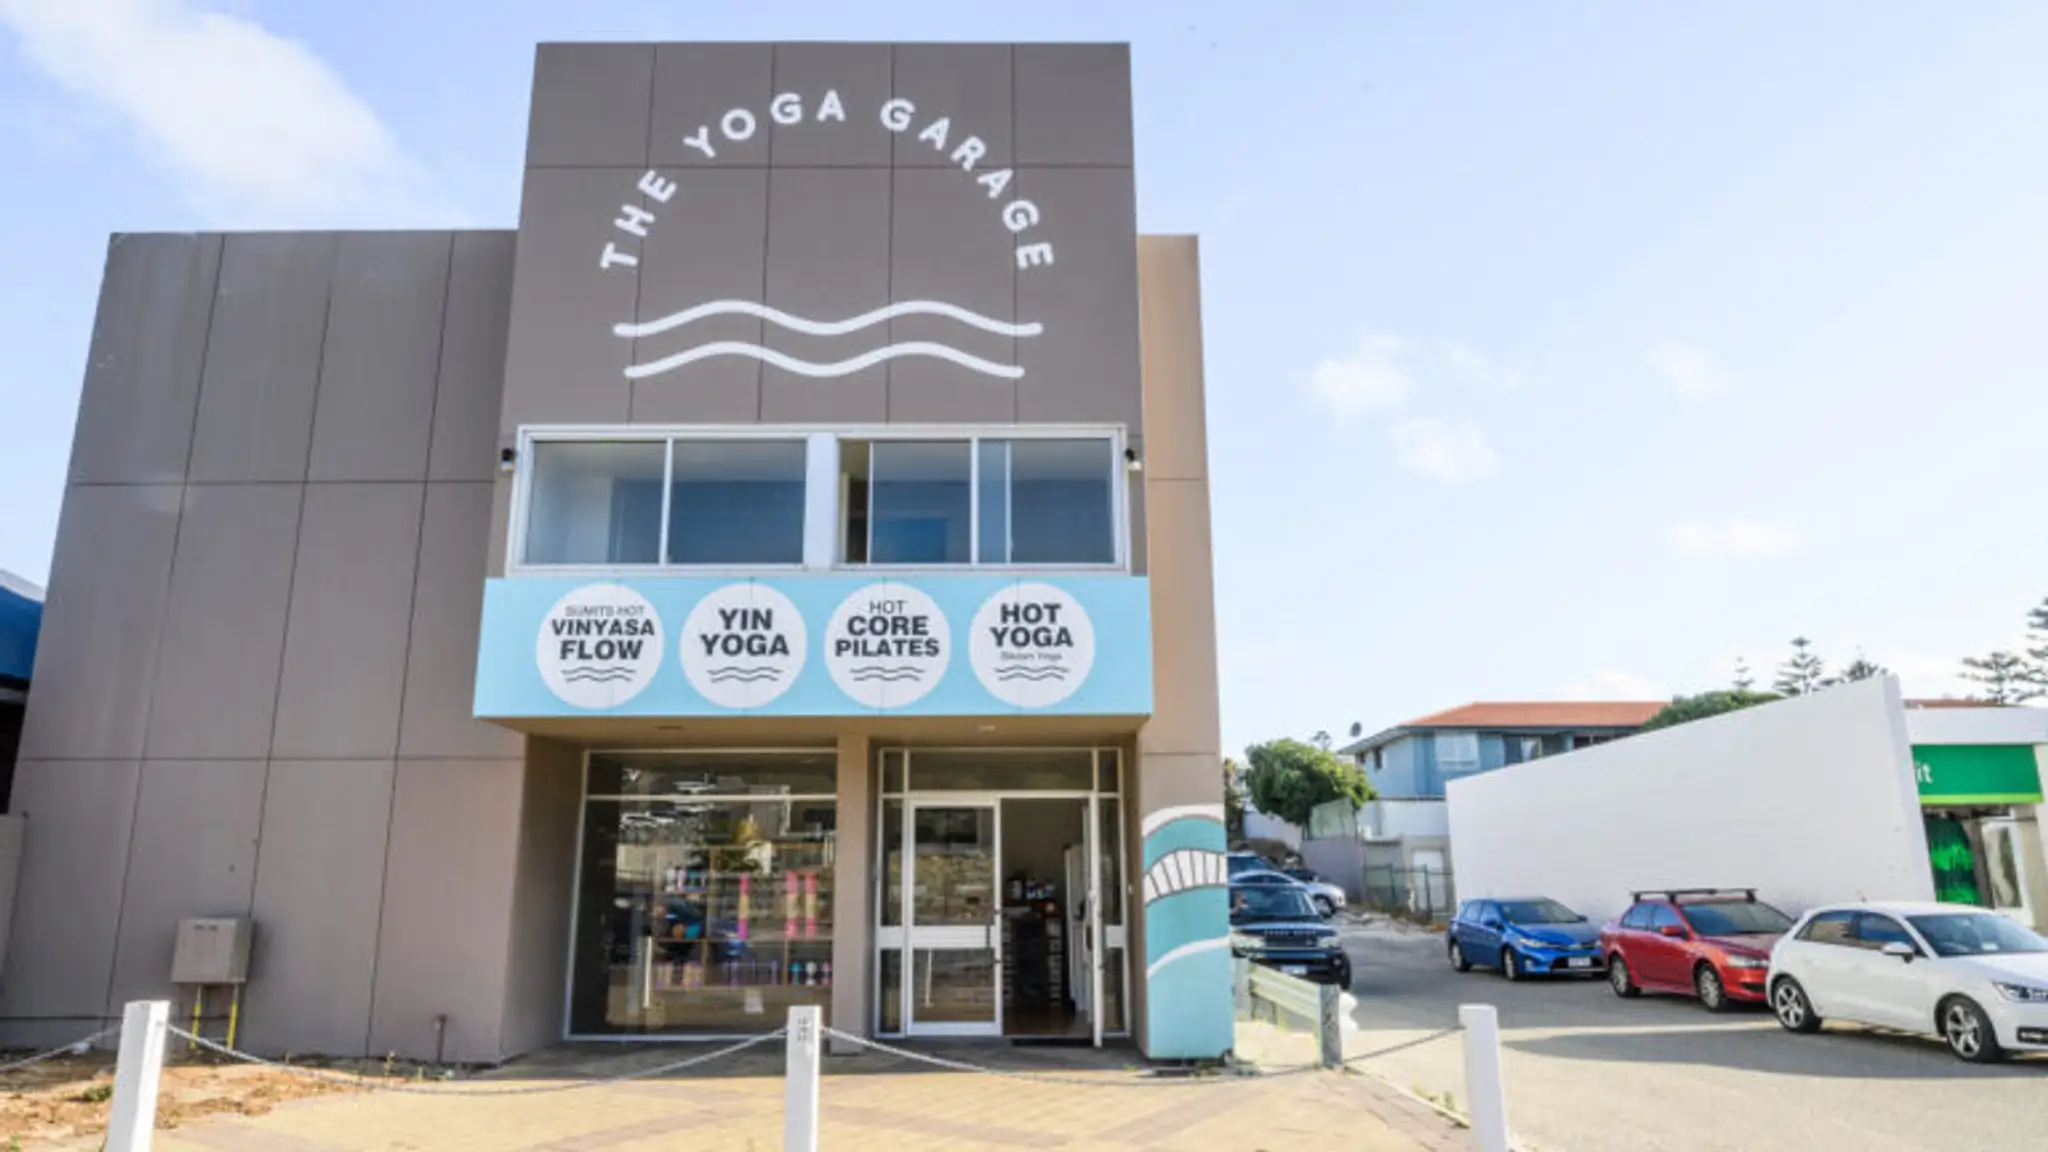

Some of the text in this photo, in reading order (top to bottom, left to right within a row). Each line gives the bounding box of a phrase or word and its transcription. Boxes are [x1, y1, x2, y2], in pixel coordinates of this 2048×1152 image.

[600, 89, 1055, 270] THE YOGA GARAGE
[869, 600, 906, 614] HOT
[1000, 603, 1062, 624] HOT
[551, 618, 655, 636] VINYASA
[718, 608, 773, 631] YIN
[847, 615, 929, 636] CORE
[700, 633, 790, 656] YOGA
[835, 638, 940, 657] PILATES
[989, 627, 1073, 648] YOGA
[559, 639, 644, 660] FLOW
